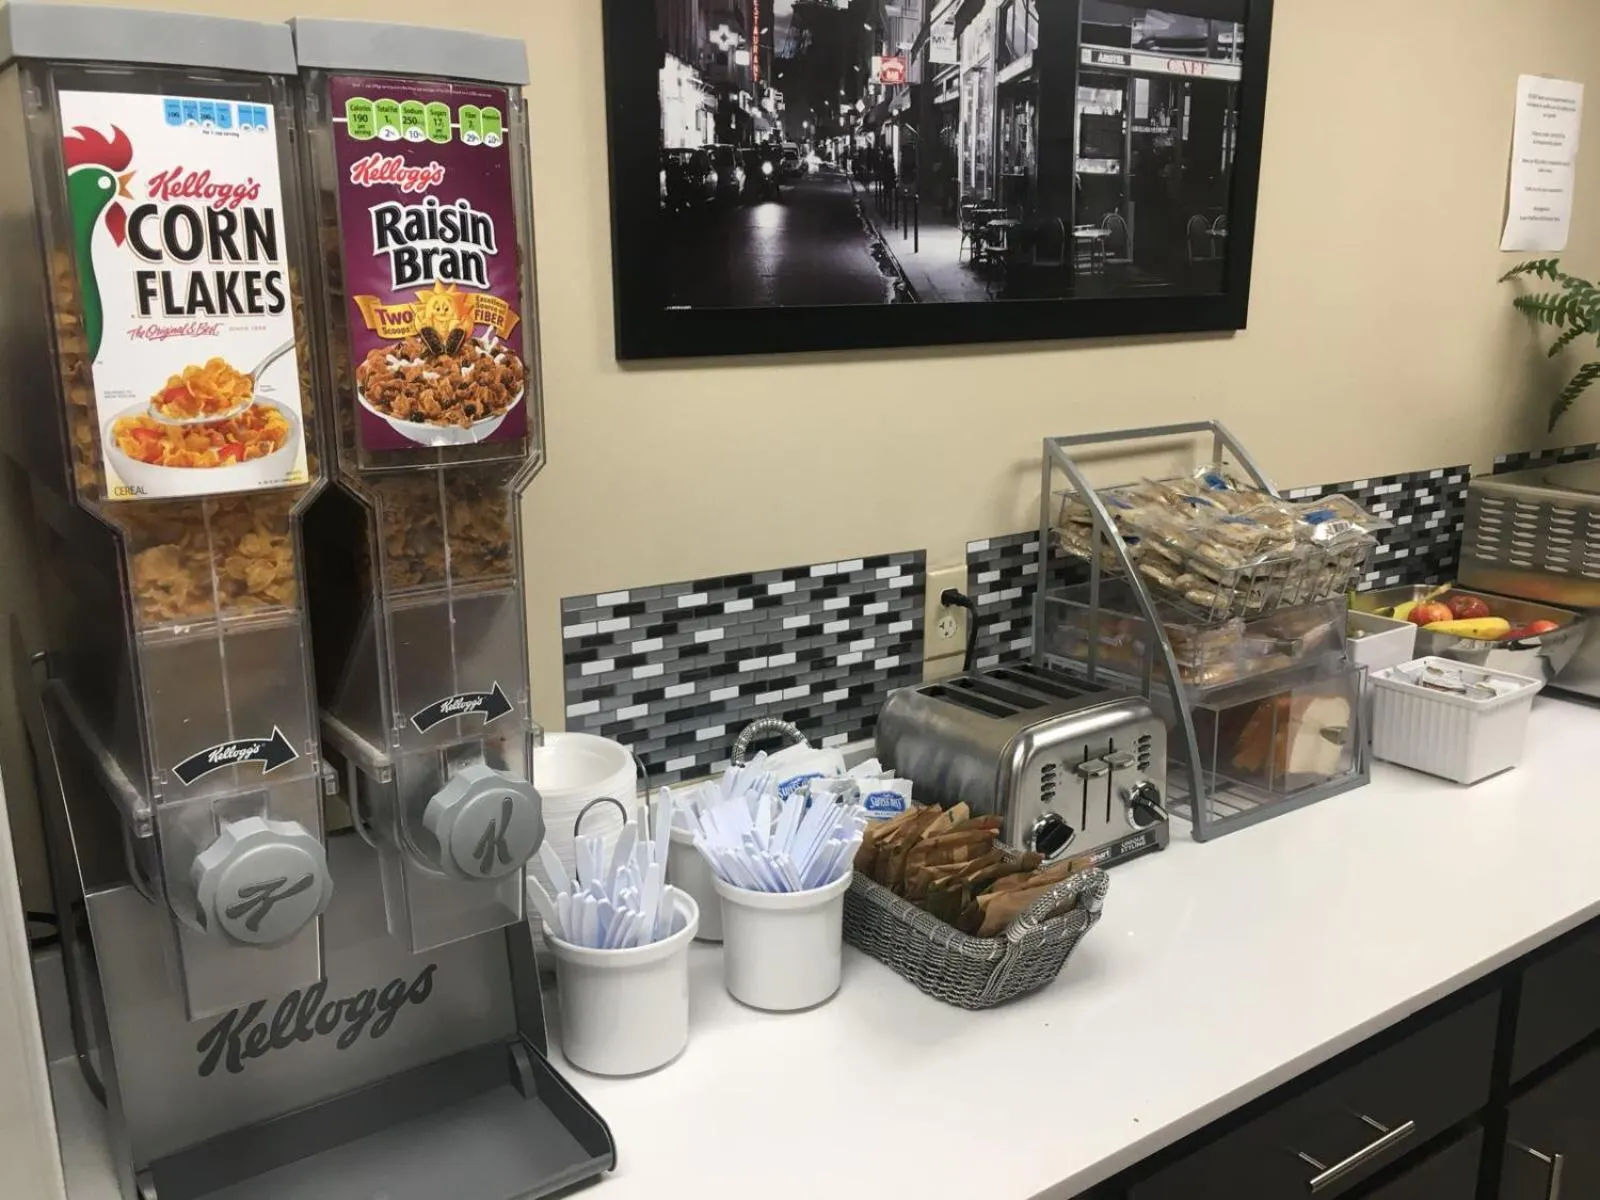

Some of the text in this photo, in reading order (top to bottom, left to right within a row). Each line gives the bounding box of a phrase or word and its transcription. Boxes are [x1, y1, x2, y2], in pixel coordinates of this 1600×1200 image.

[353, 113, 368, 123] 190
[352, 154, 444, 191] Kellogg's
[148, 166, 261, 209] Kellogg's
[127, 203, 279, 263] CORN
[373, 198, 495, 251] Raisin
[393, 245, 487, 286] Bran
[135, 270, 286, 317] FLAKES
[145, 323, 187, 341] Original
[474, 309, 505, 327] FIBER
[114, 485, 148, 497] CEREAL
[440, 696, 484, 713] Kellogg's
[208, 743, 261, 763] Kellogg's
